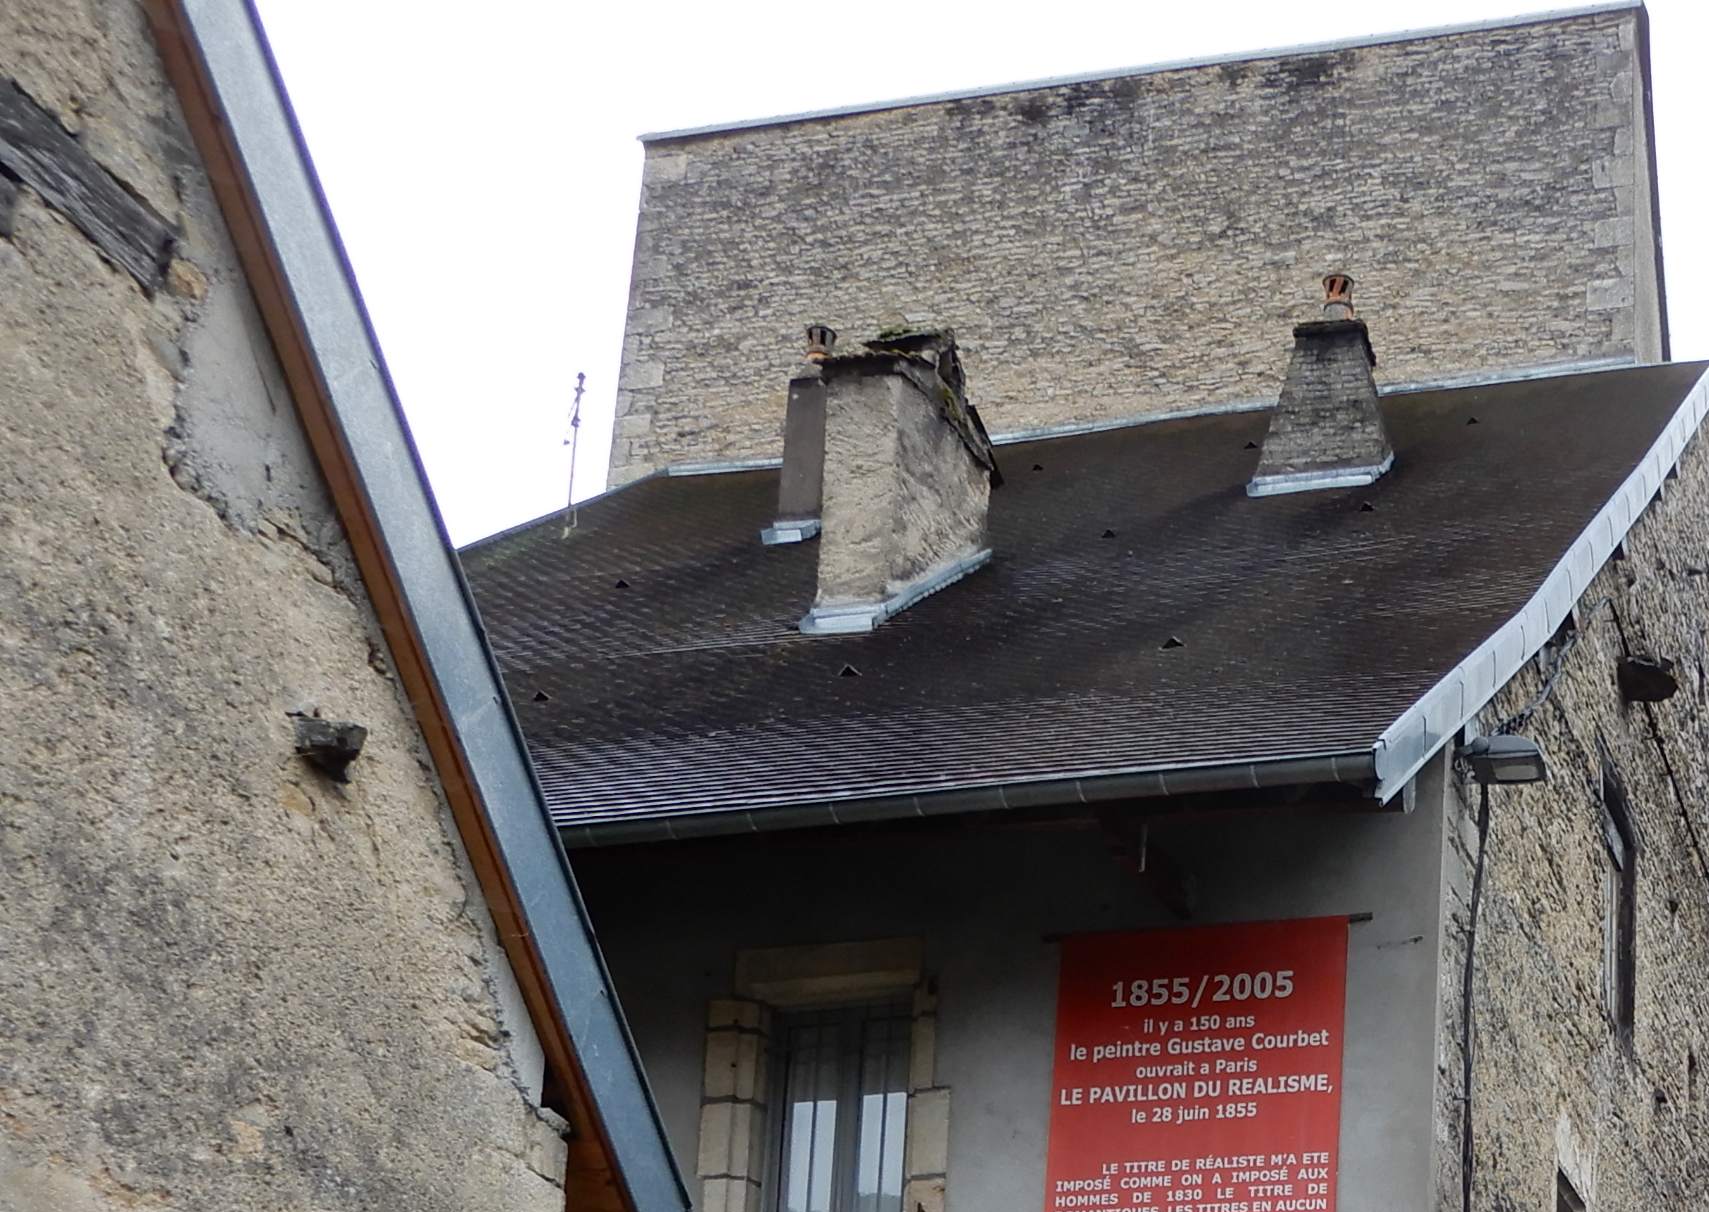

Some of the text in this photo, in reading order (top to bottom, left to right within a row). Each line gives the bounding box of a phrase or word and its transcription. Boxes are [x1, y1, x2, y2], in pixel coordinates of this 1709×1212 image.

[1111, 970, 1293, 1007] 1855/2005
[1144, 1014, 1255, 1035] il y a 150 ans
[1070, 1029, 1328, 1062] le peintre Gustave Courbet
[1136, 1057, 1256, 1077] ouvrait a Paris
[1061, 1074, 1332, 1104] LE PAVILLON DU REALISME,
[1132, 1102, 1256, 1123] le 28 juin 1855
[1102, 1163, 1117, 1174] LE
[1124, 1160, 1165, 1172] TITRE
[1171, 1159, 1189, 1170] DE
[1196, 1155, 1264, 1169] RÉALISTE
[1302, 1152, 1328, 1164] ETE
[1056, 1166, 1328, 1191] IMPOSÉ COMME ON A IMPOSÉ AUX
[1055, 1183, 1327, 1206] HOMMES DE 1830 LE TITRE DE
[1253, 1201, 1271, 1212] EN
[1275, 1198, 1326, 1210] AUCUN
